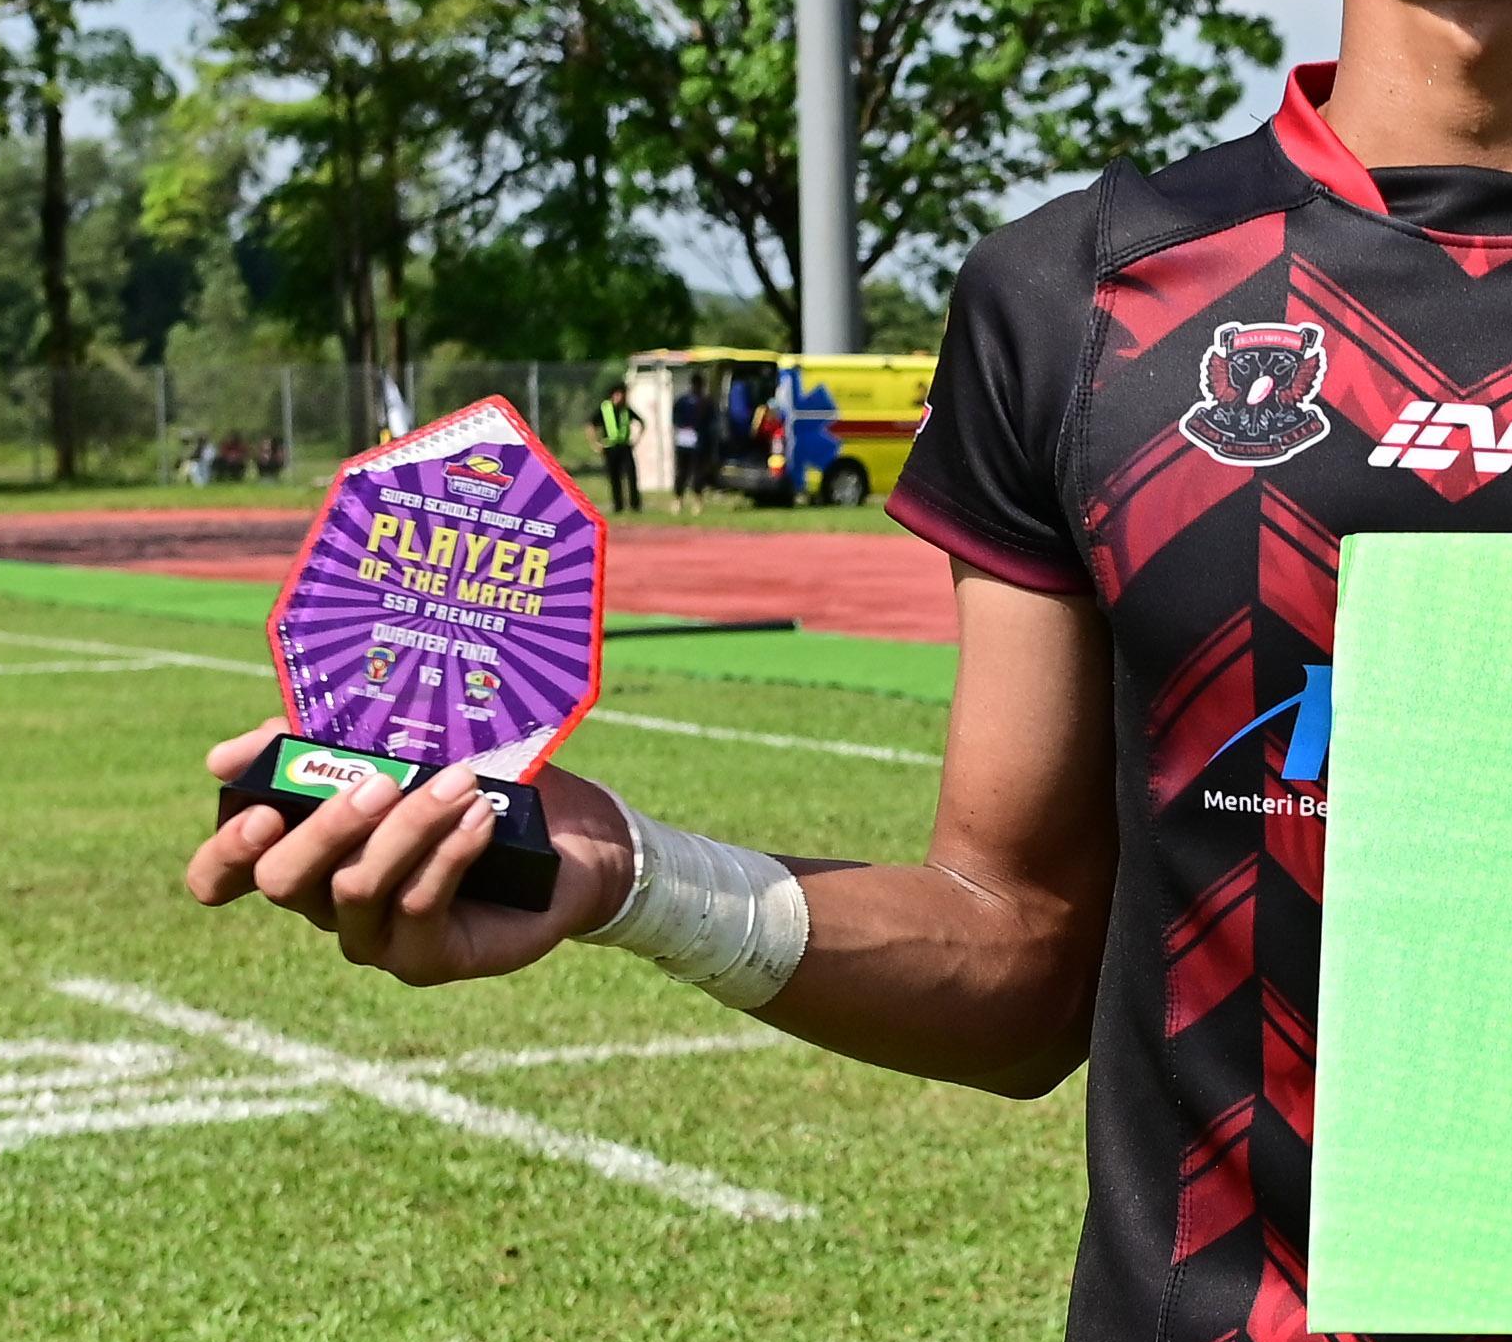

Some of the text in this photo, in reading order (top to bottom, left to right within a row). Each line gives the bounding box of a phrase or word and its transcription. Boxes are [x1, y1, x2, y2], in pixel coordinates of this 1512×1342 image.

[379, 487, 423, 509] SUPER
[423, 497, 480, 521] SCHOOLS
[480, 509, 523, 531] RUGBY
[366, 512, 550, 588] PLAYER
[357, 558, 544, 616] OF THE MATCH
[382, 593, 506, 632] SSR PREMIER
[371, 622, 501, 665] QUARTER FINAL
[419, 665, 443, 686] VS
[303, 760, 364, 783] MILO
[1203, 789, 1293, 816] Menteri
